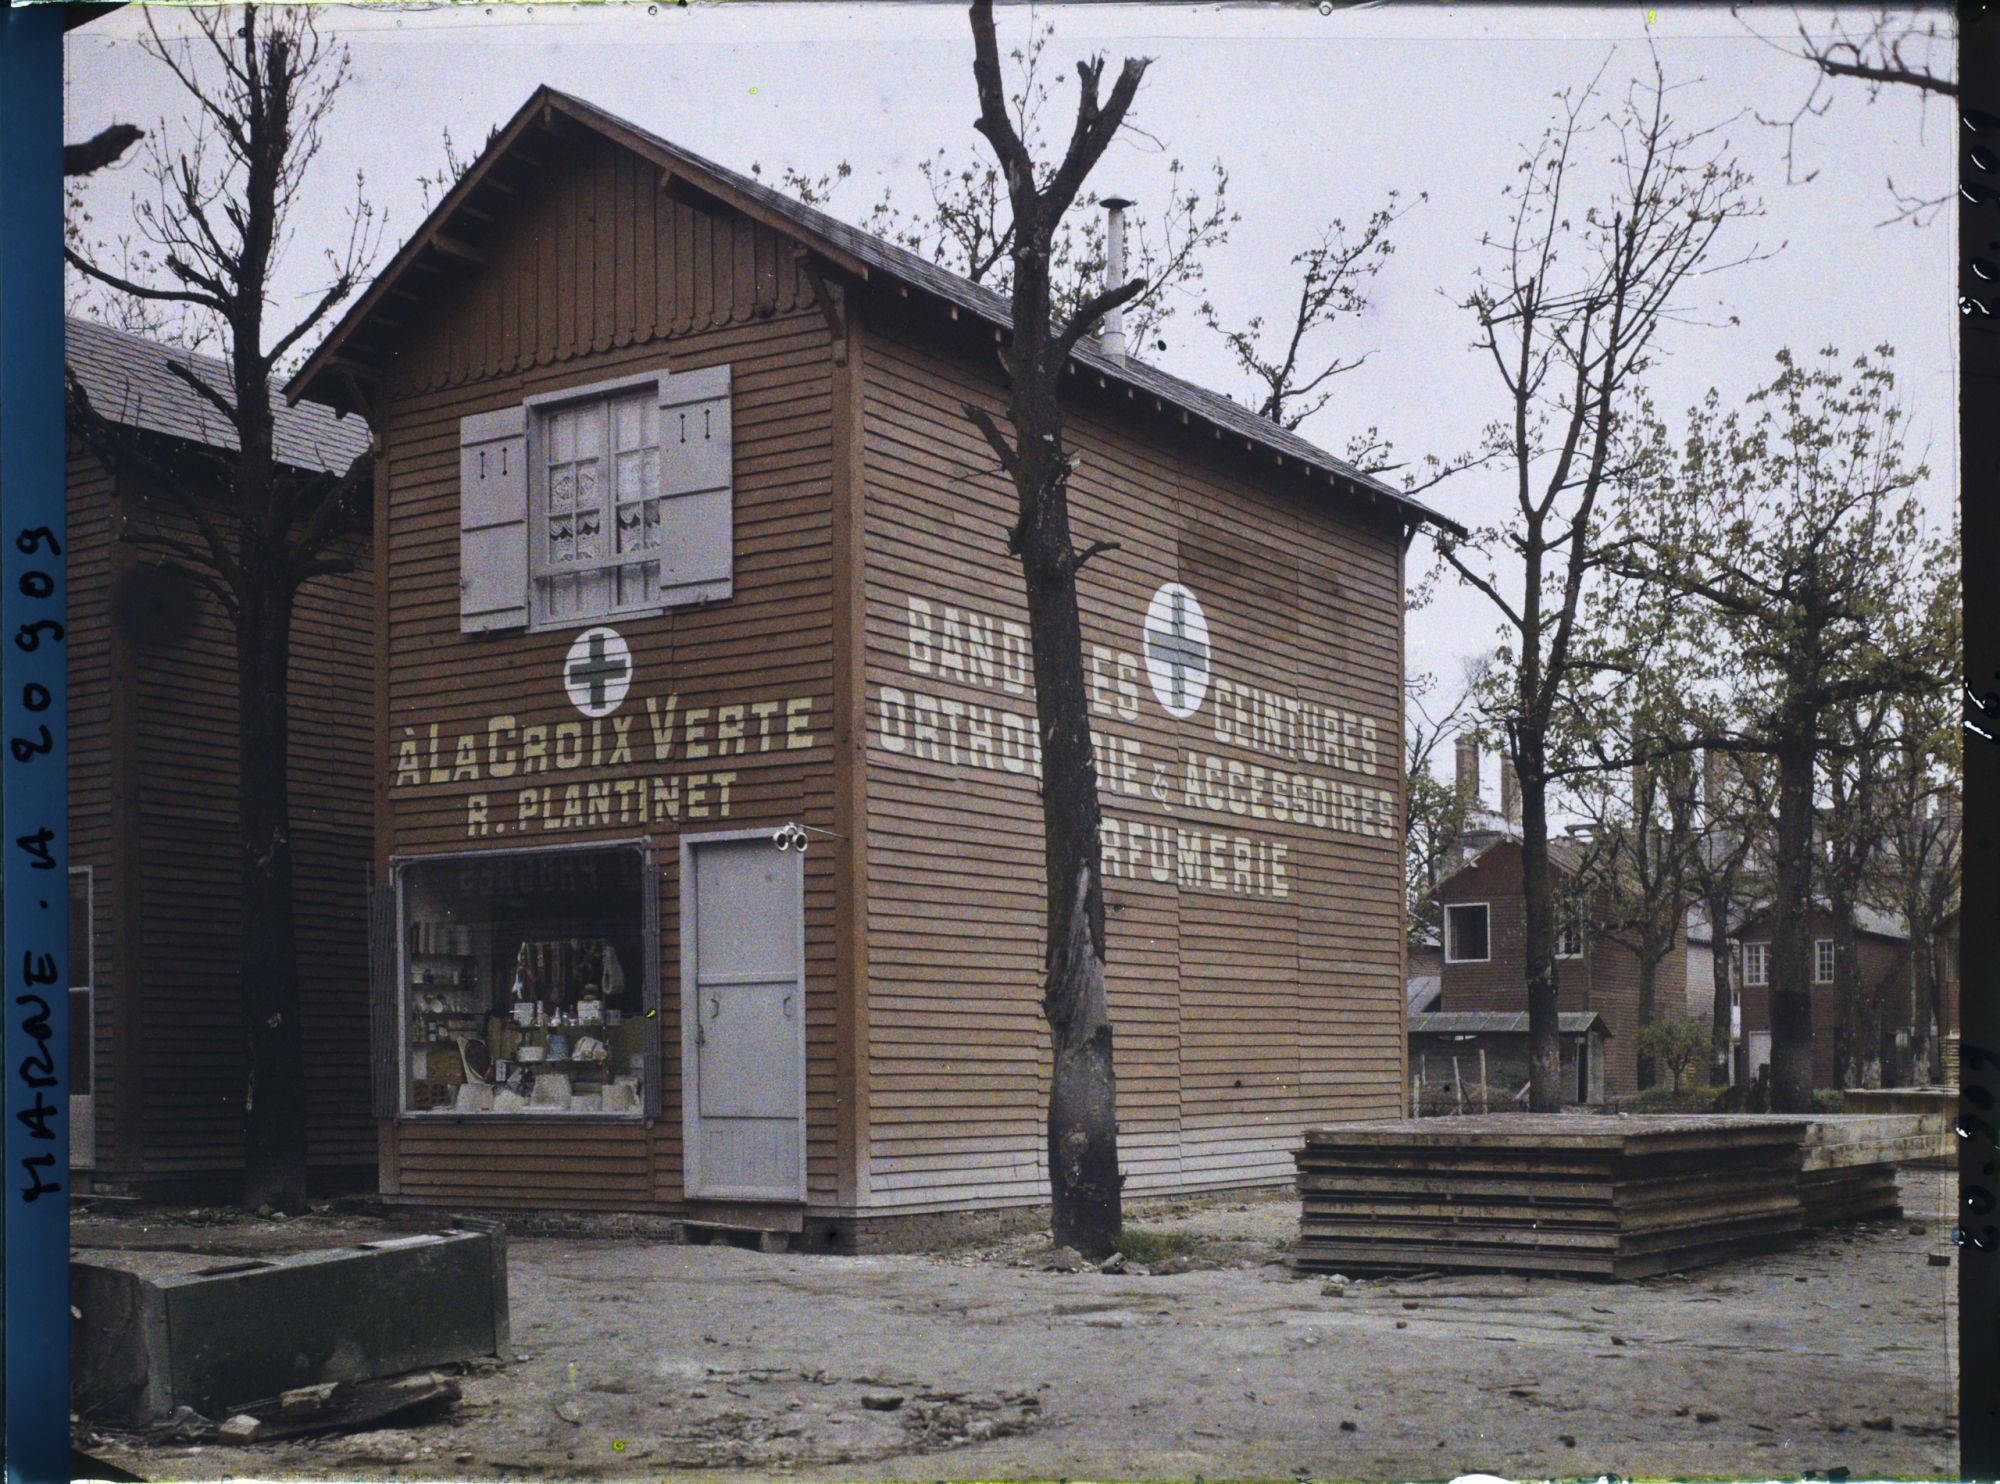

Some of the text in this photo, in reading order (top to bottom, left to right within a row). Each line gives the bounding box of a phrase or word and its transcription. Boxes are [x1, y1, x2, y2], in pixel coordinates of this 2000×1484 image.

[908, 597, 1377, 775] BANDES CEINTURES
[429, 723, 479, 783] LA
[488, 715, 633, 778] CROIX
[646, 692, 813, 760] VERTE
[880, 686, 1393, 839] ORTHOIE & ACCESSOIRES
[518, 772, 737, 831] PLANTINET
[1100, 816, 1289, 897] RFUMERIE
